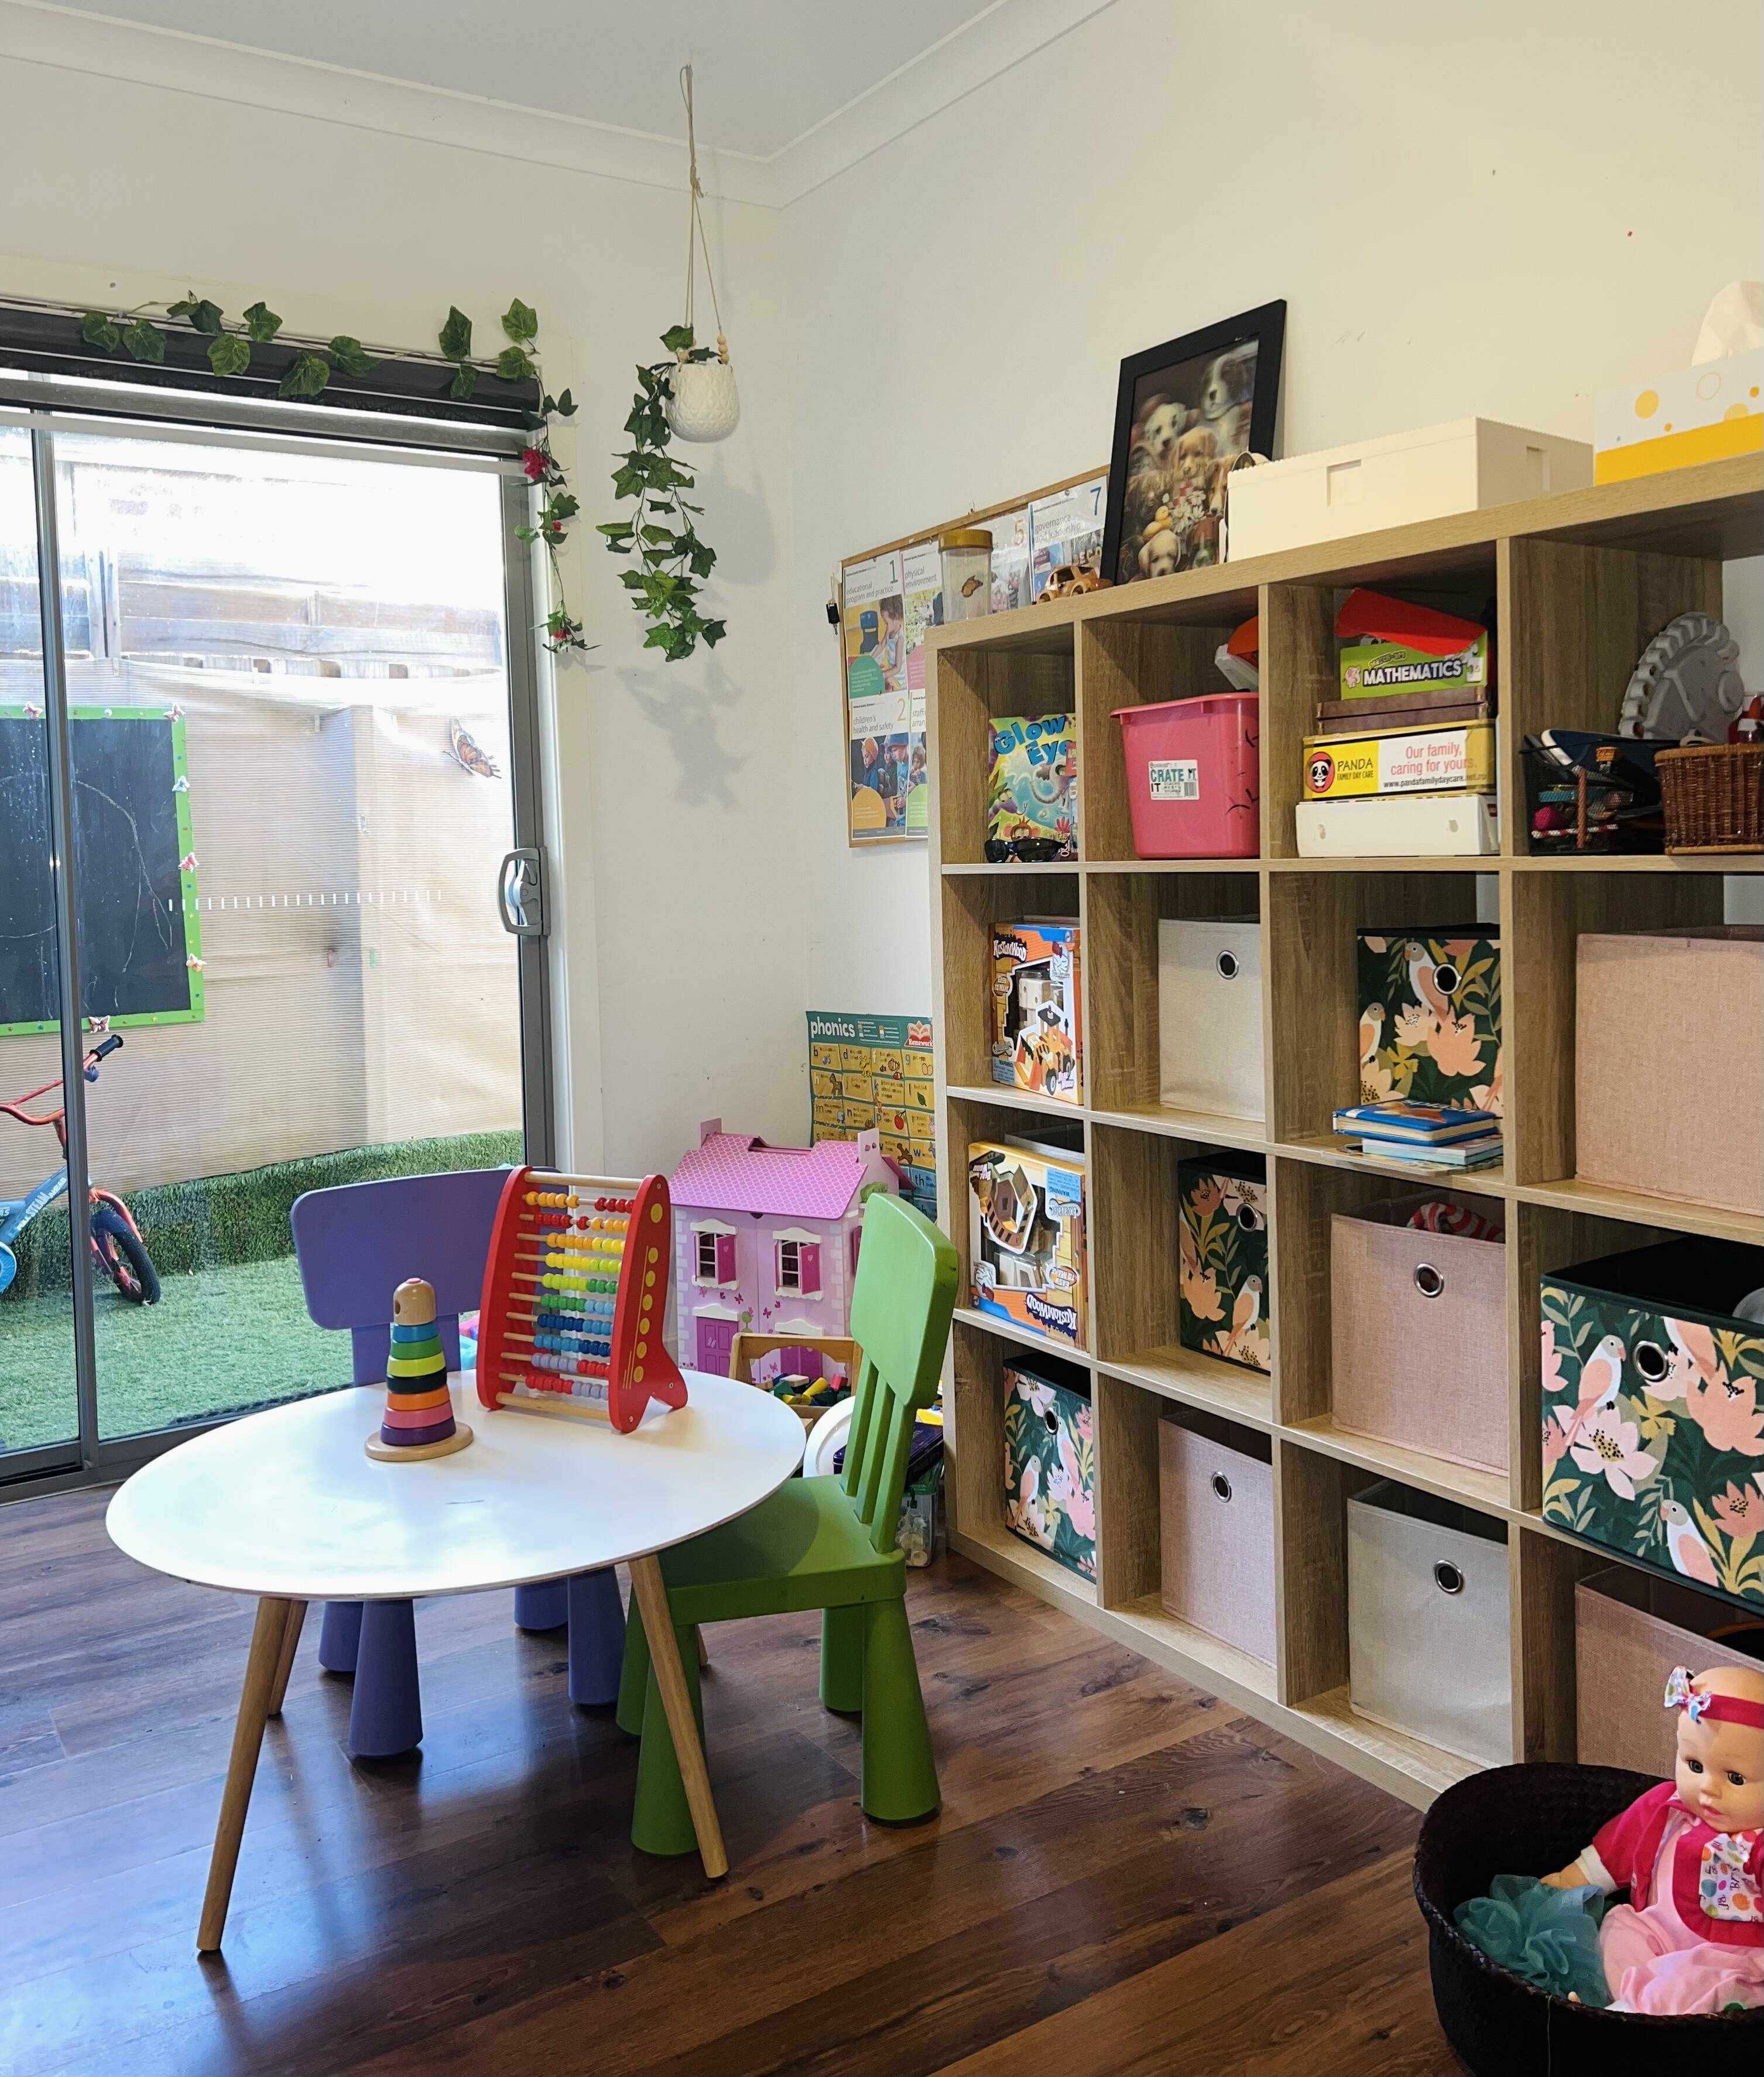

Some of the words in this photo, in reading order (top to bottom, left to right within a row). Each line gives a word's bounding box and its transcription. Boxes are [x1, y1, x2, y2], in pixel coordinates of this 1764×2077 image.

[1090, 487, 1101, 515] 7
[1013, 518, 1025, 546] 5
[1035, 514, 1071, 534] governance
[1035, 532, 1047, 543] and
[1048, 522, 1081, 539] leadership
[889, 560, 898, 584] 1
[905, 566, 924, 580] physical
[846, 581, 872, 595] educational
[905, 574, 937, 589] environment
[847, 592, 865, 604] program
[866, 589, 875, 599] and
[875, 586, 893, 598] practice
[1364, 660, 1462, 686] MATHEMATICS
[897, 698, 906, 722] 2
[853, 714, 876, 726] children's
[853, 725, 868, 734] health
[869, 723, 878, 731] and
[879, 722, 894, 731] safety
[994, 715, 1067, 755] Glow
[1025, 740, 1074, 767] Eye
[1406, 745, 1424, 759] Our
[1427, 741, 1462, 757] family,
[1337, 758, 1373, 772] PANDA
[1390, 762, 1423, 776] caring
[1426, 759, 1441, 772] for
[1150, 768, 1184, 782] CRATE
[1337, 772, 1352, 781] FAMILY
[1362, 770, 1374, 779] CARE
[1151, 782, 1162, 792] IT
[810, 1016, 855, 1038] phonics
[843, 1048, 848, 1059] d
[874, 1079, 878, 1091] k
[914, 1173, 924, 1186] th
[25, 1191, 51, 1217] STEAM
